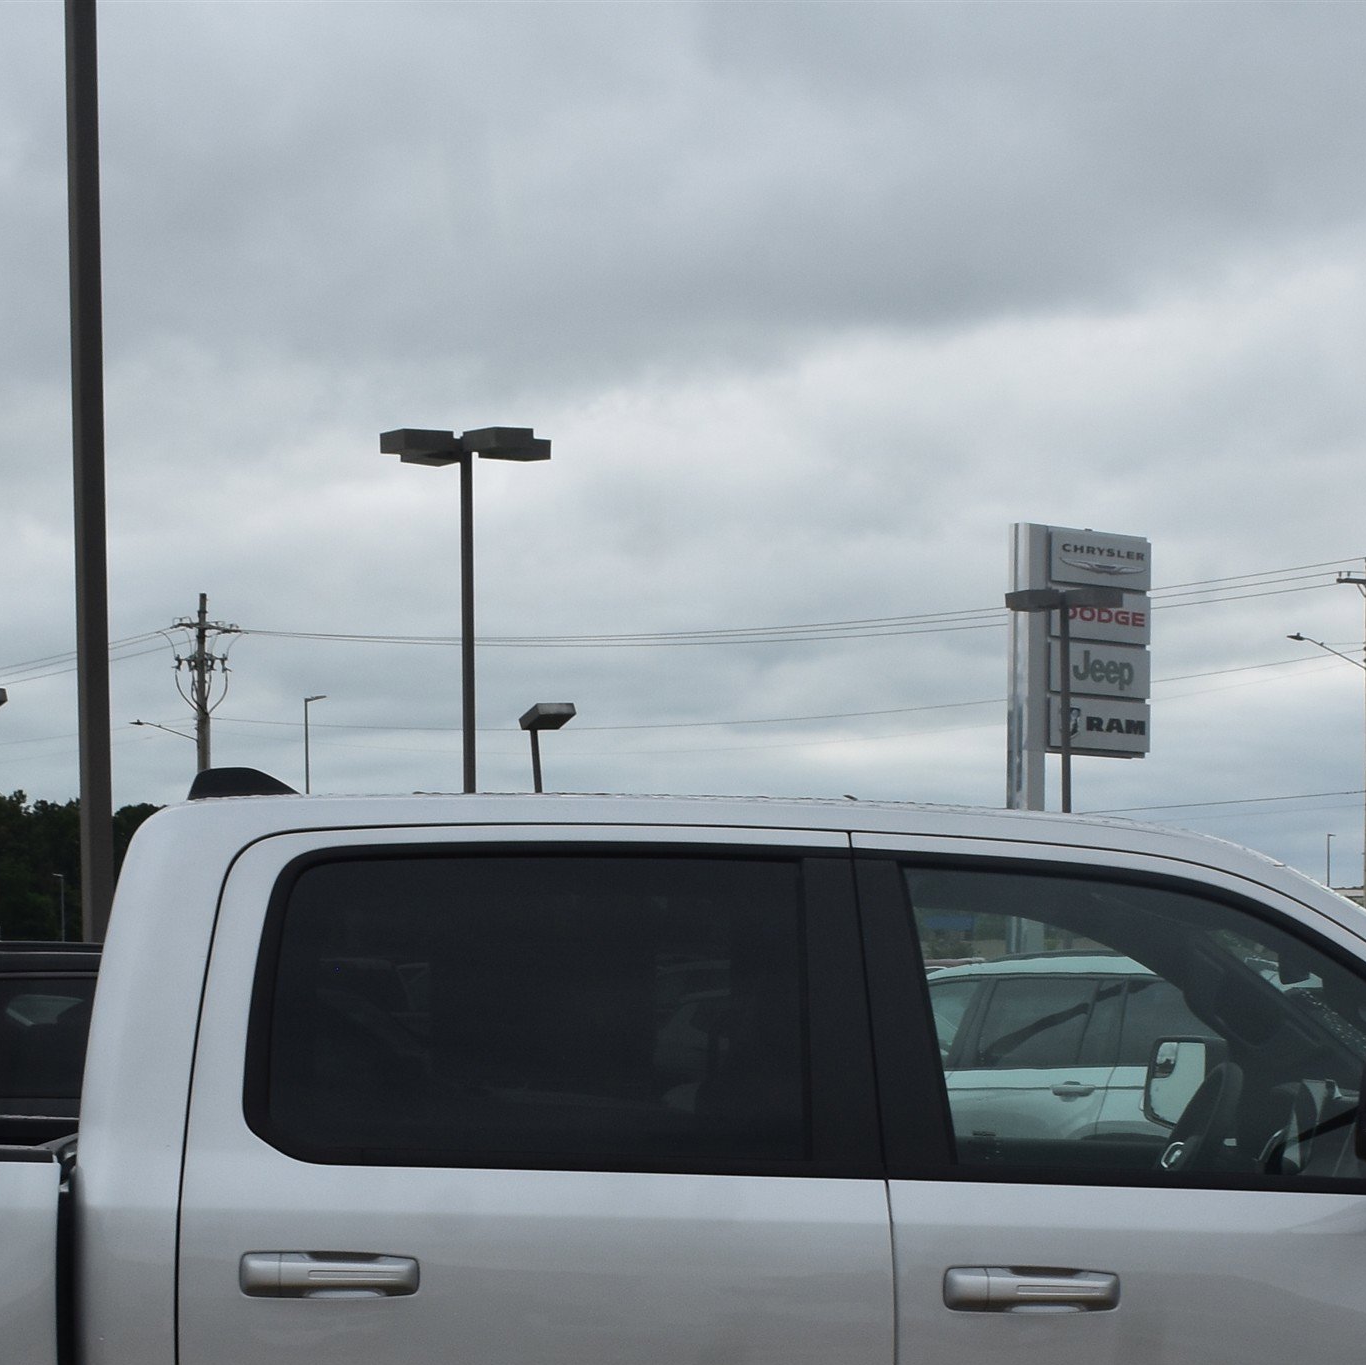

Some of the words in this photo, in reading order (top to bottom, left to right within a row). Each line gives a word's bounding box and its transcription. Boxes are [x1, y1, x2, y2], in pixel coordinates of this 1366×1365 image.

[1061, 543, 1145, 561] CHRYSLER
[1072, 650, 1134, 691] Jeep
[1086, 716, 1146, 736] RAM
